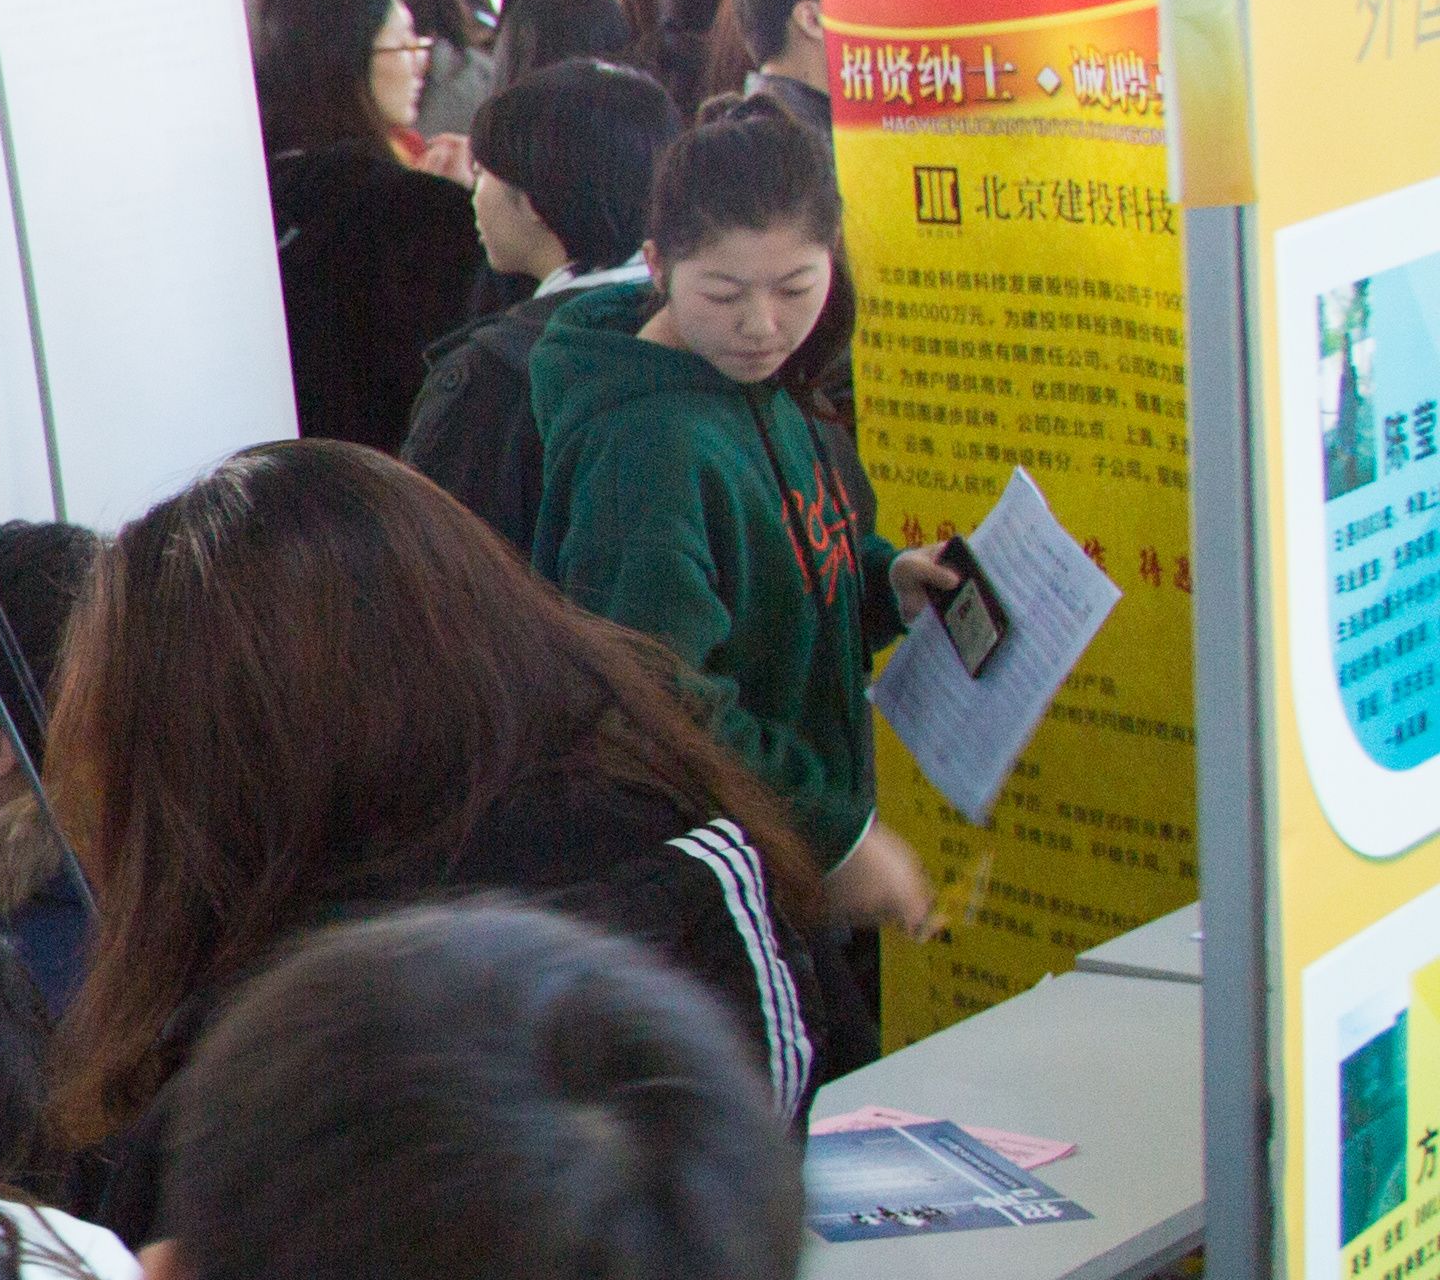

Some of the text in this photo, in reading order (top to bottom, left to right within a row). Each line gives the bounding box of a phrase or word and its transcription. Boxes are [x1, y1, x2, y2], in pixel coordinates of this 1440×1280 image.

[839, 42, 1019, 106] 招贤纳士
[974, 174, 1177, 237] 北京建投科技
